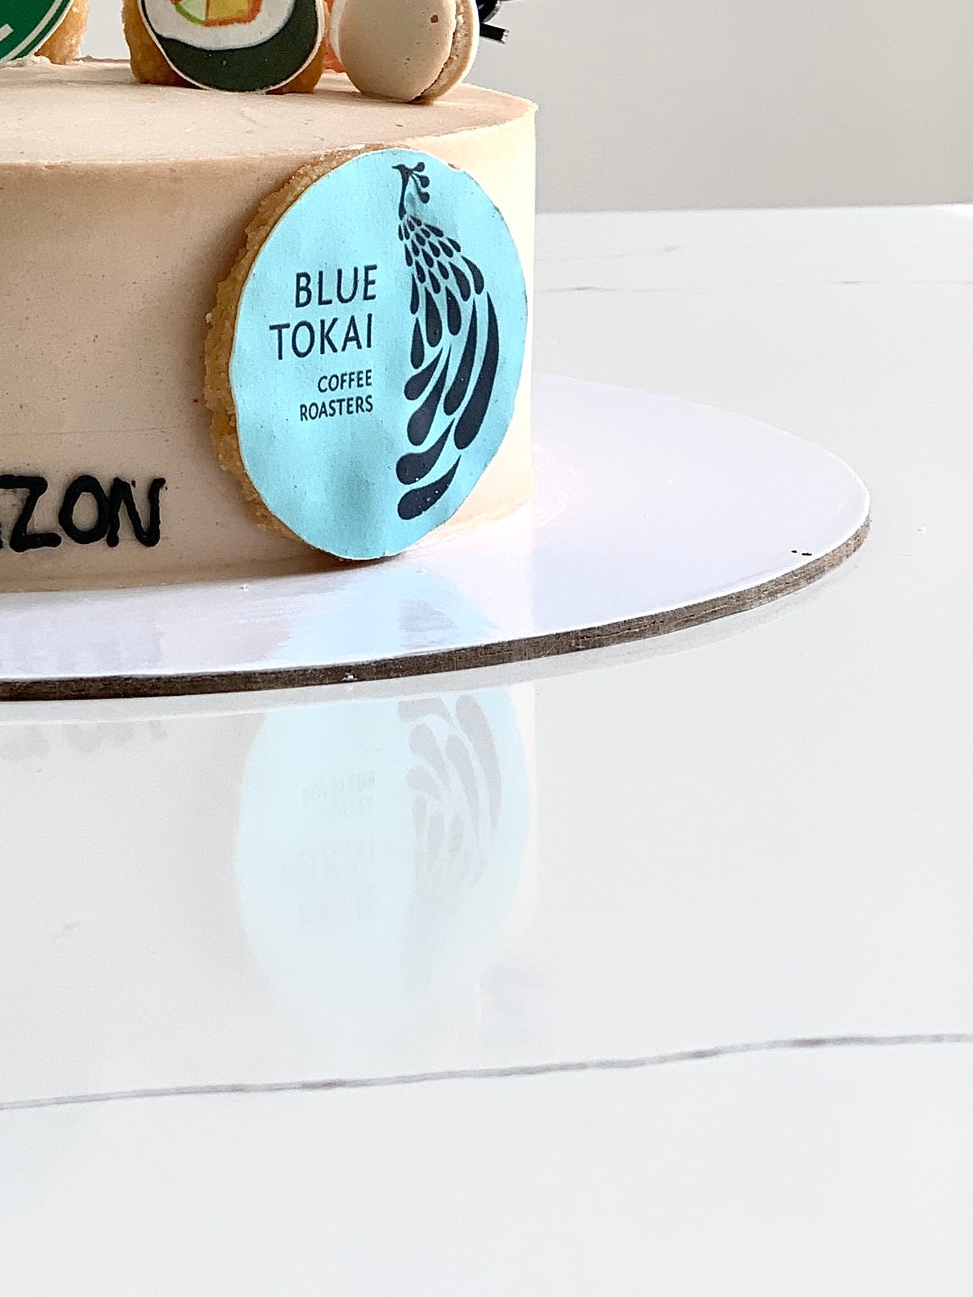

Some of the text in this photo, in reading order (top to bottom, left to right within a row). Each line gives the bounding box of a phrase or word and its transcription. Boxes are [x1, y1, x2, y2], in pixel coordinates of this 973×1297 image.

[294, 263, 378, 309] BLUE
[268, 313, 373, 361] TOKAI
[316, 368, 373, 393] COFFEE
[299, 395, 374, 422] ROASTERS
